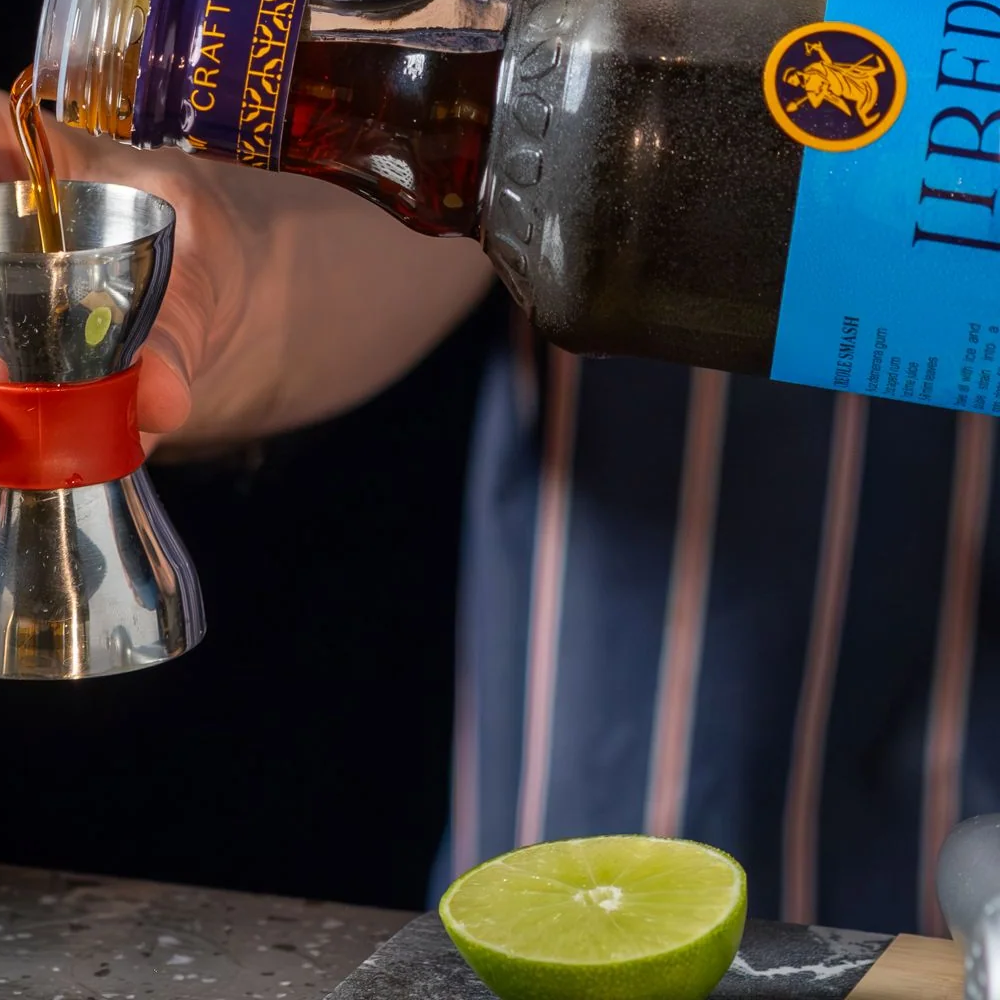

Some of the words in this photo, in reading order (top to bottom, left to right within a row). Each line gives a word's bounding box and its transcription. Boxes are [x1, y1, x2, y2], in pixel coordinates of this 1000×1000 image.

[191, 0, 231, 112] CRAFT
[840, 316, 860, 360] SMASH
[875, 327, 888, 349] gum
[967, 322, 981, 344] and
[988, 325, 1000, 334] a
[963, 347, 977, 363] ice
[982, 343, 997, 361] into
